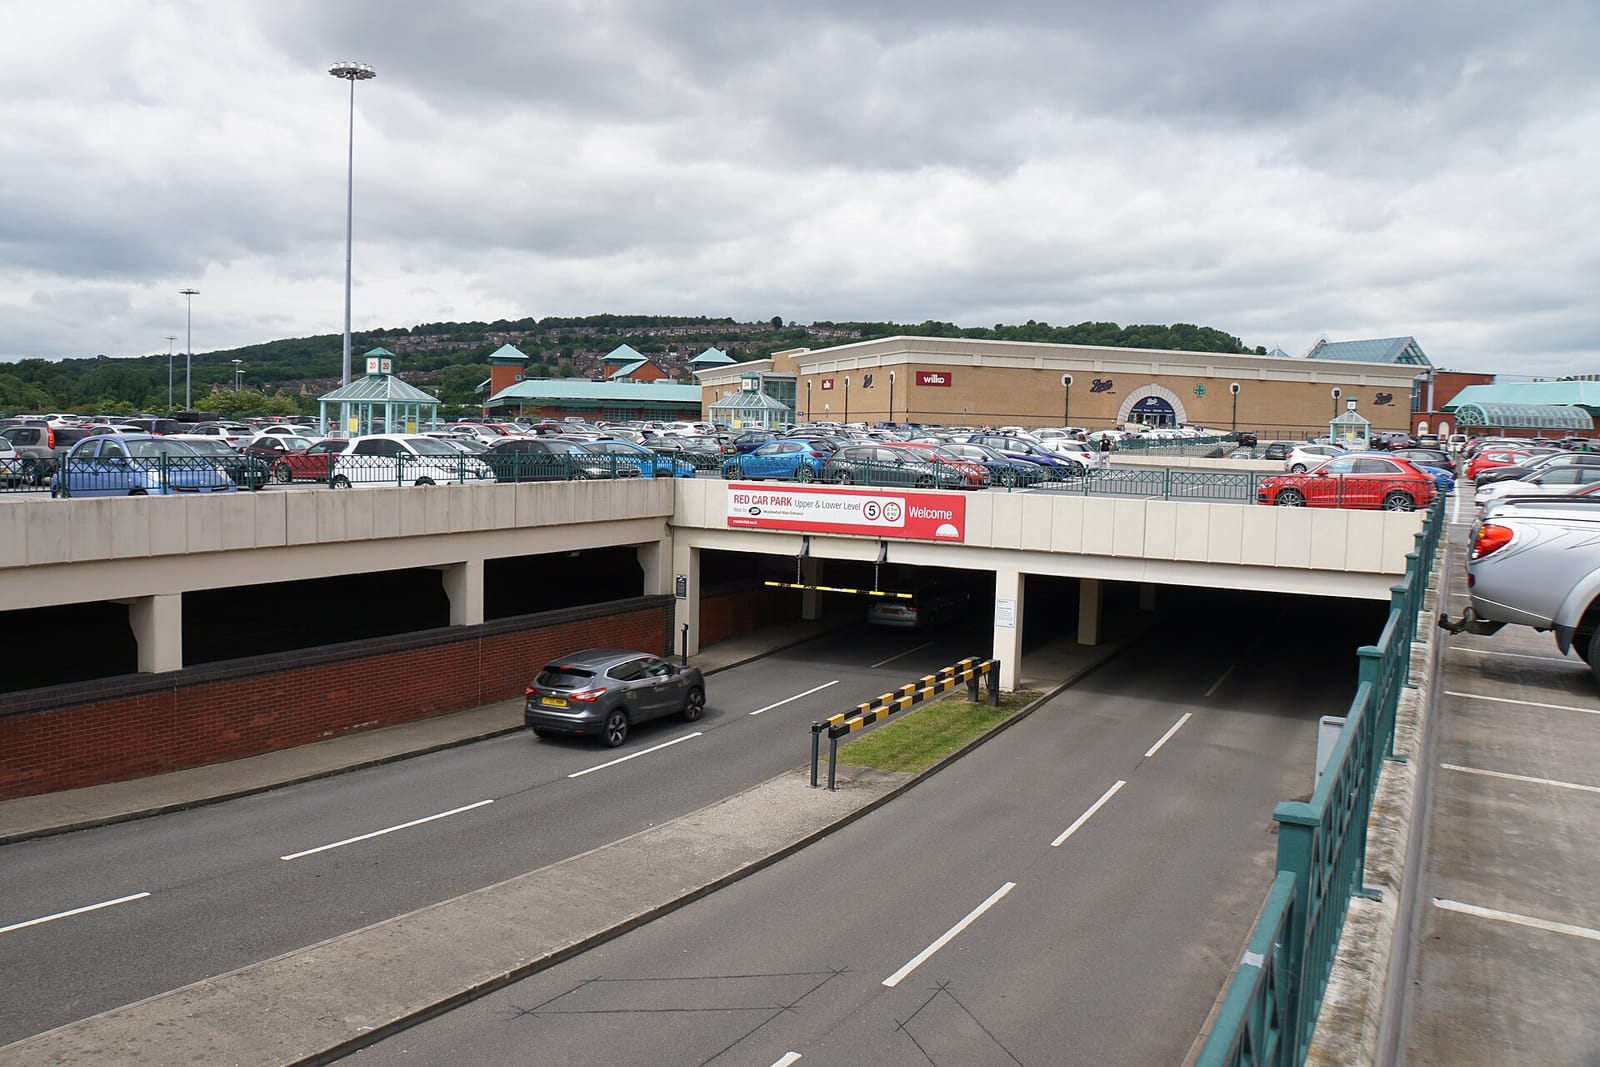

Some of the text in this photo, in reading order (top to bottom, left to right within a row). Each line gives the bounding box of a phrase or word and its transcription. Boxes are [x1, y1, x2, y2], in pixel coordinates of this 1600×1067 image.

[923, 373, 945, 384] wilko
[733, 494, 861, 511] RED CAR PARK Upper & Lower Level
[868, 505, 876, 517] 5
[908, 506, 953, 520] Welcome
